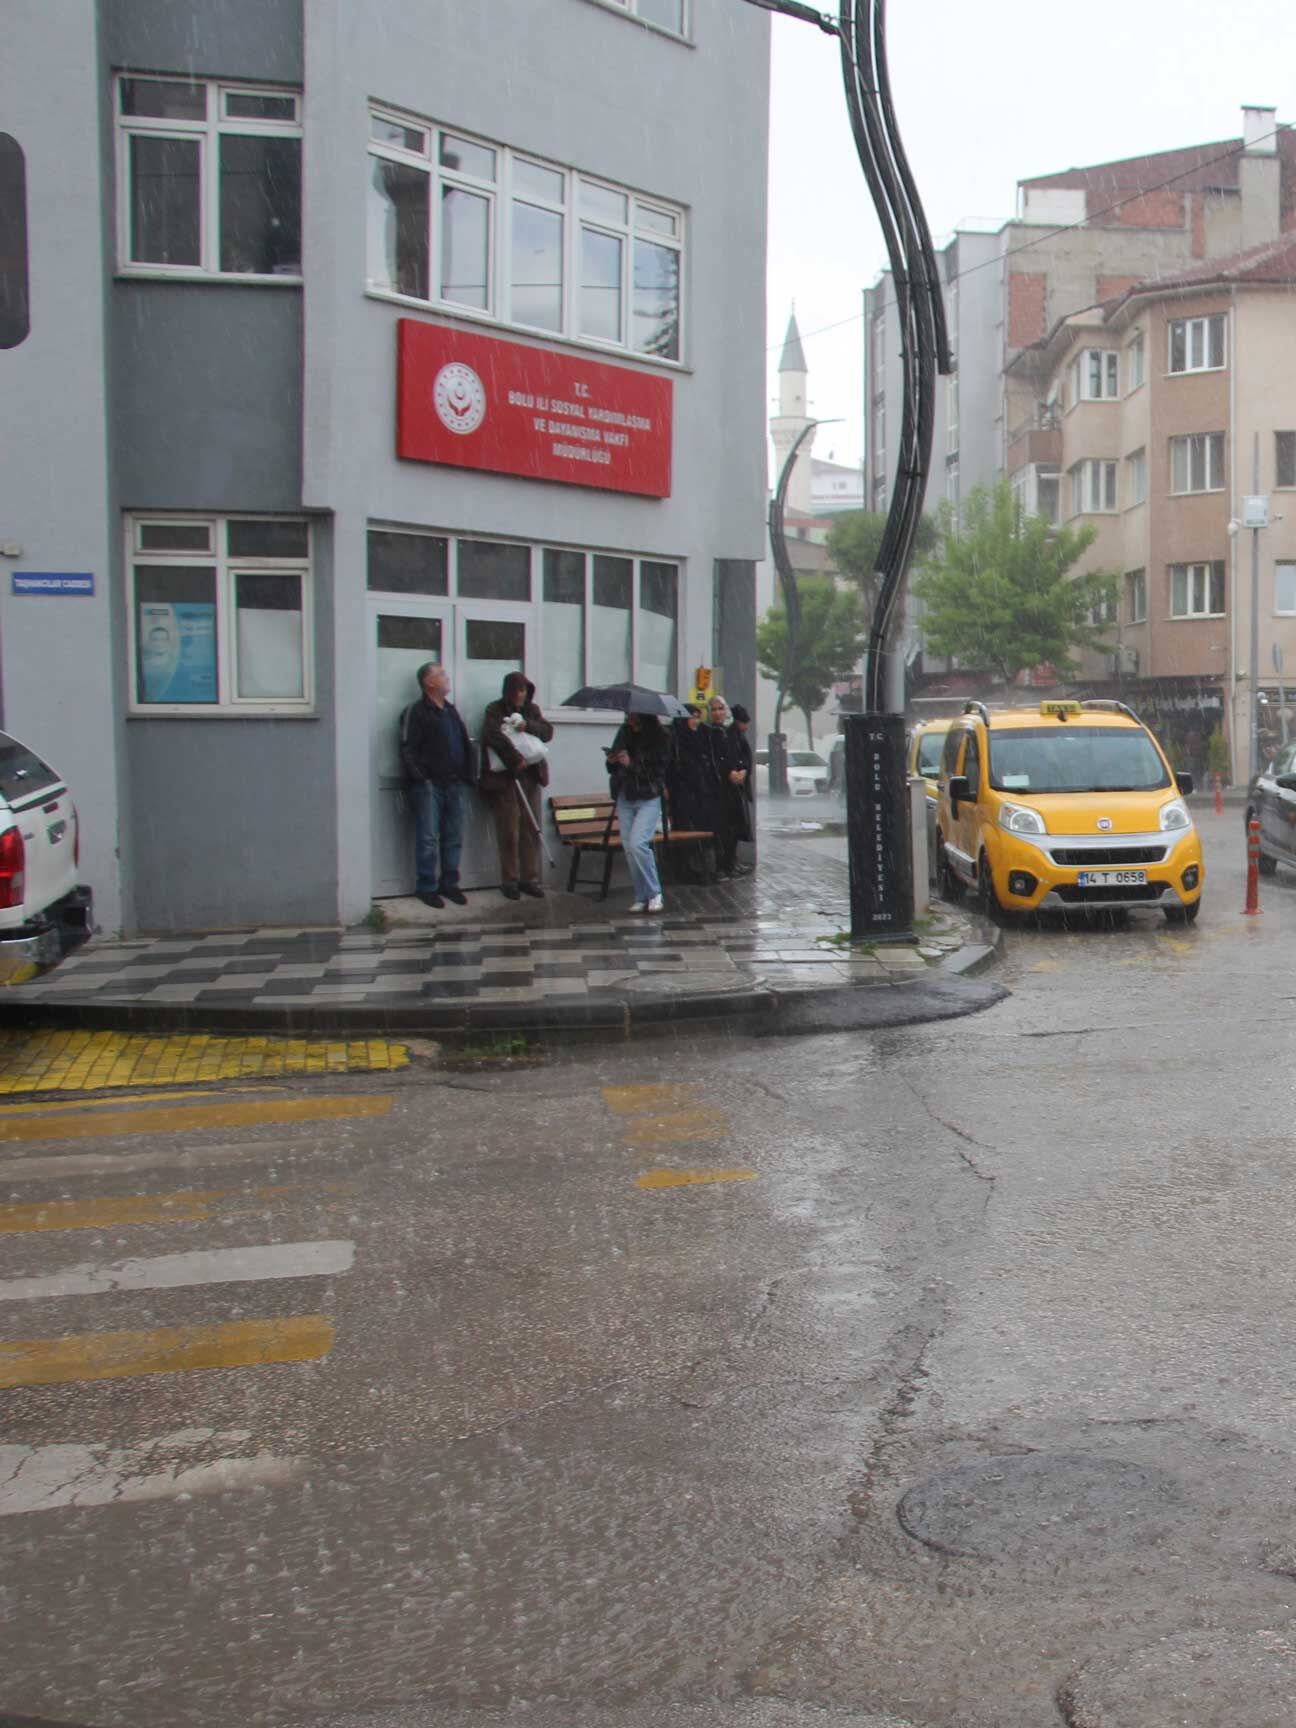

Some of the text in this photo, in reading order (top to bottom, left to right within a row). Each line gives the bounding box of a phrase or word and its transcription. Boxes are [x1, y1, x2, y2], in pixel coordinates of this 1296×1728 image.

[508, 390, 534, 408] BOLU
[1086, 871, 1145, 884] 14 T 0658
